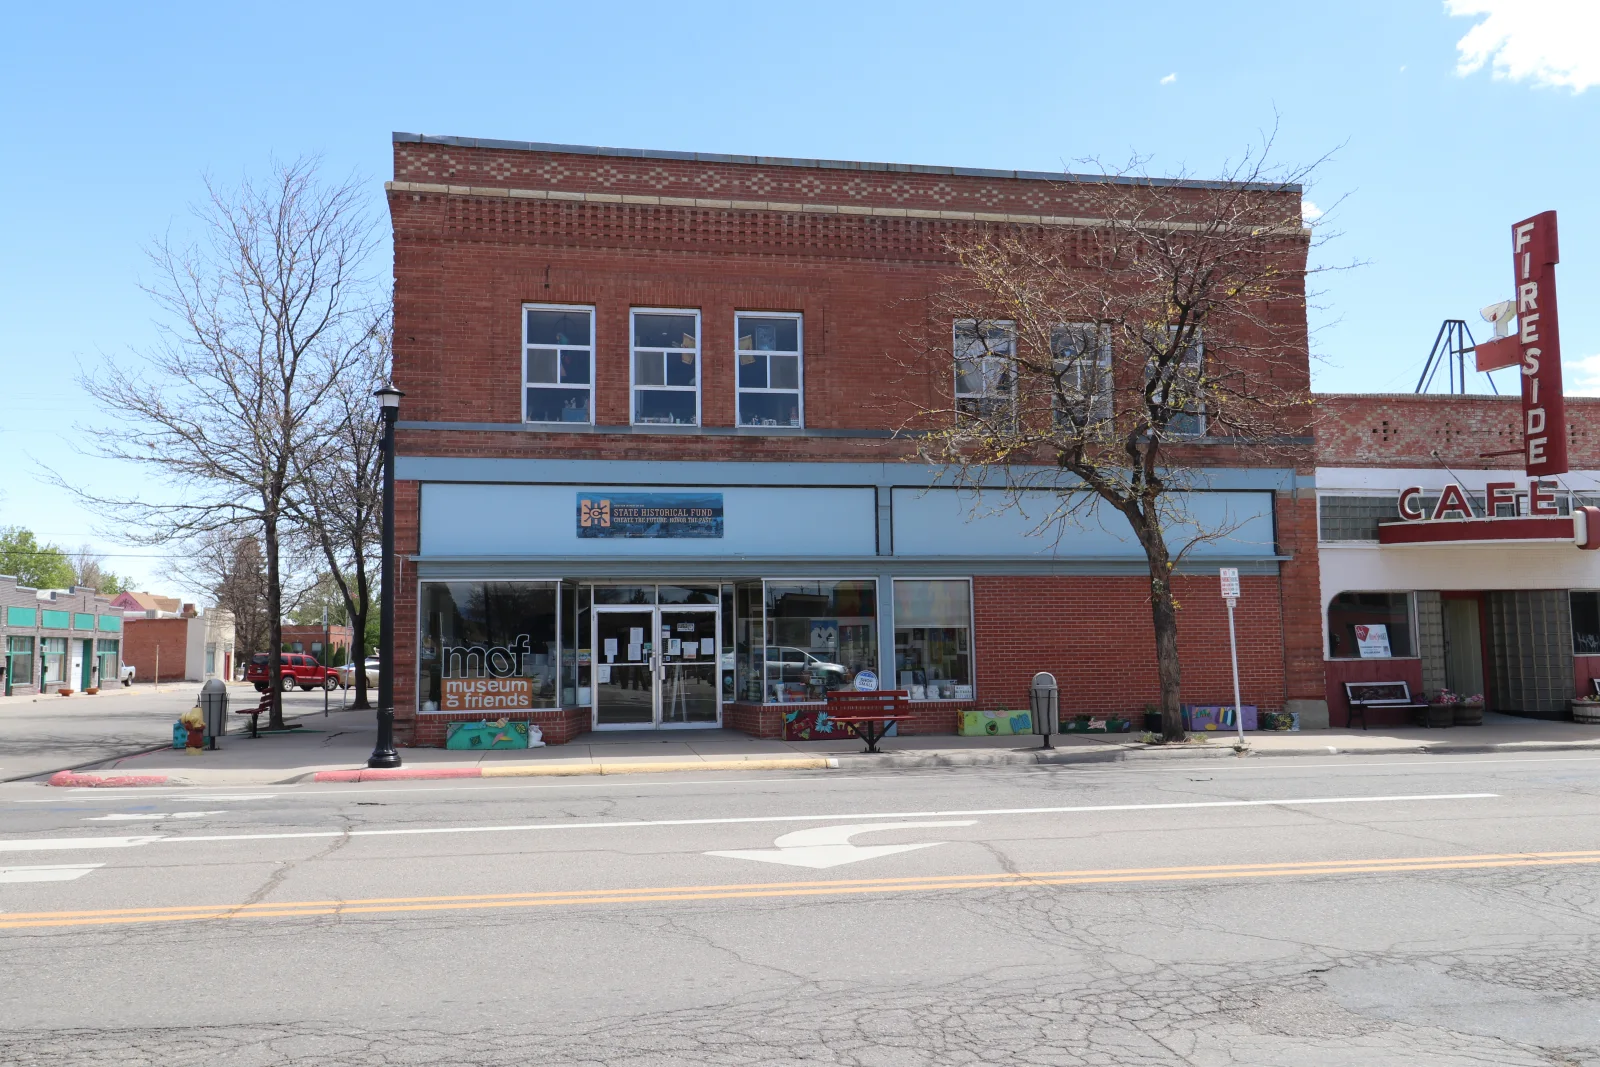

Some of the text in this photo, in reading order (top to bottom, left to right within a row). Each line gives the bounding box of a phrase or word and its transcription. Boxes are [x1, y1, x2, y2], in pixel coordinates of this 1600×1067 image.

[1514, 222, 1548, 466] FIRESIDE
[613, 508, 713, 517] STATE HISTORICAL FUND
[1398, 481, 1559, 522] CAFE
[442, 633, 531, 679] mof
[446, 680, 528, 693] museum
[464, 692, 529, 708] friends
